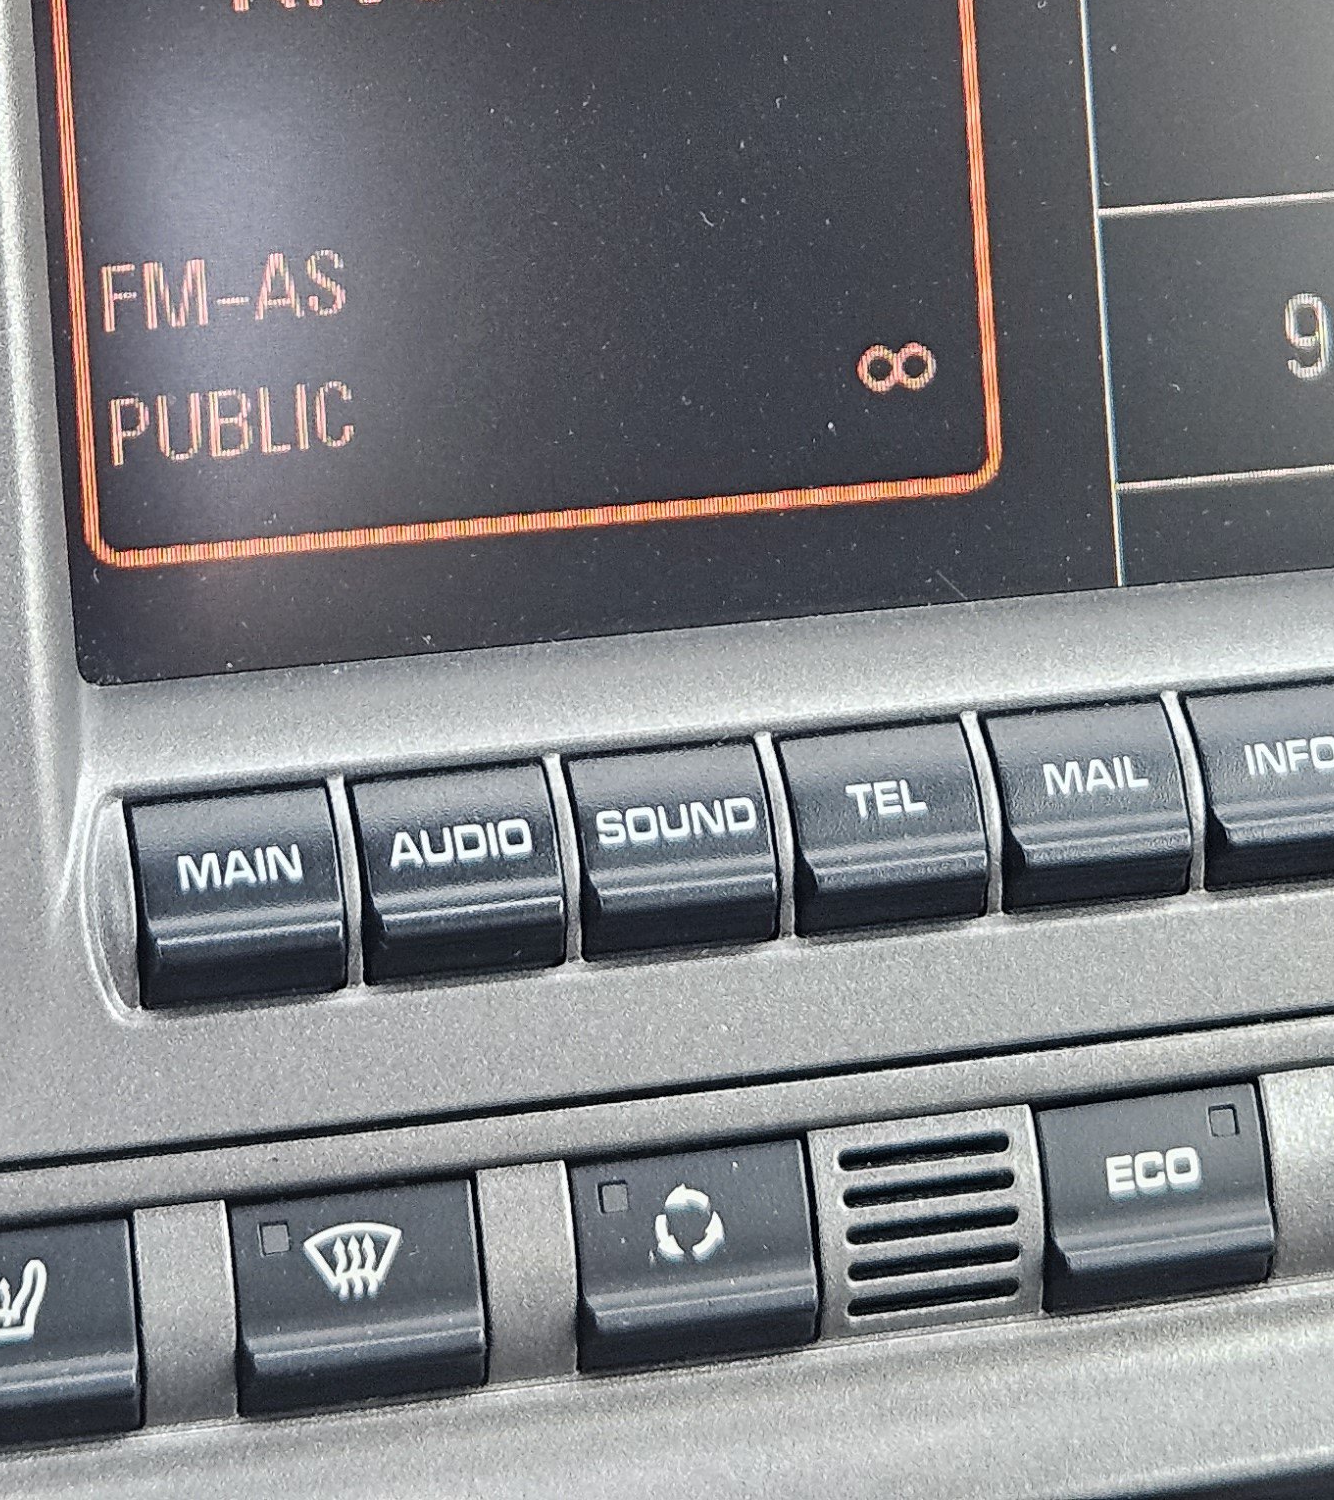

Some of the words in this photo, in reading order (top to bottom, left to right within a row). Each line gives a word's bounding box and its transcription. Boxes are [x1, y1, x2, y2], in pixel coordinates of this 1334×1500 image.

[100, 248, 347, 332] FM-AS
[109, 381, 356, 467] PUBLIC
[844, 778, 927, 817] TEL
[1043, 754, 1149, 798] MAIL
[388, 816, 534, 868] AUDIO
[594, 794, 757, 846] SOUND
[177, 842, 303, 893] MAIN
[1105, 1144, 1201, 1204] ECO
